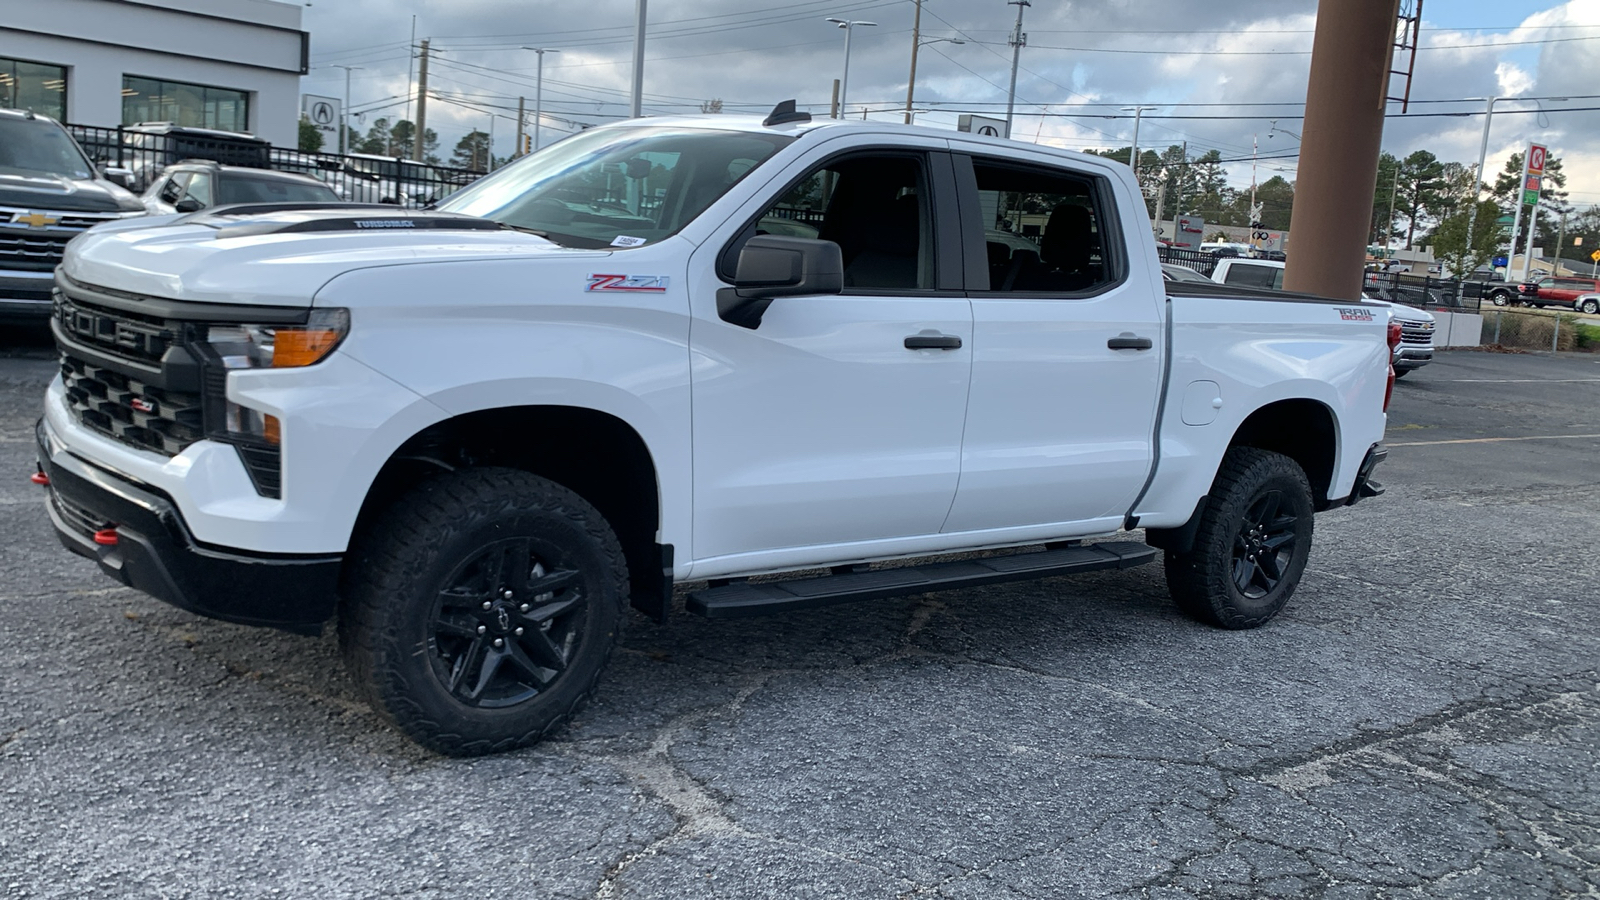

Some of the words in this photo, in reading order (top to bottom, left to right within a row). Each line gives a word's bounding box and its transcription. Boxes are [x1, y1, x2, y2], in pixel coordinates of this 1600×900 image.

[353, 220, 415, 228] TURBOMAX
[584, 273, 670, 294] Z71
[1333, 308, 1376, 316] TRAIL
